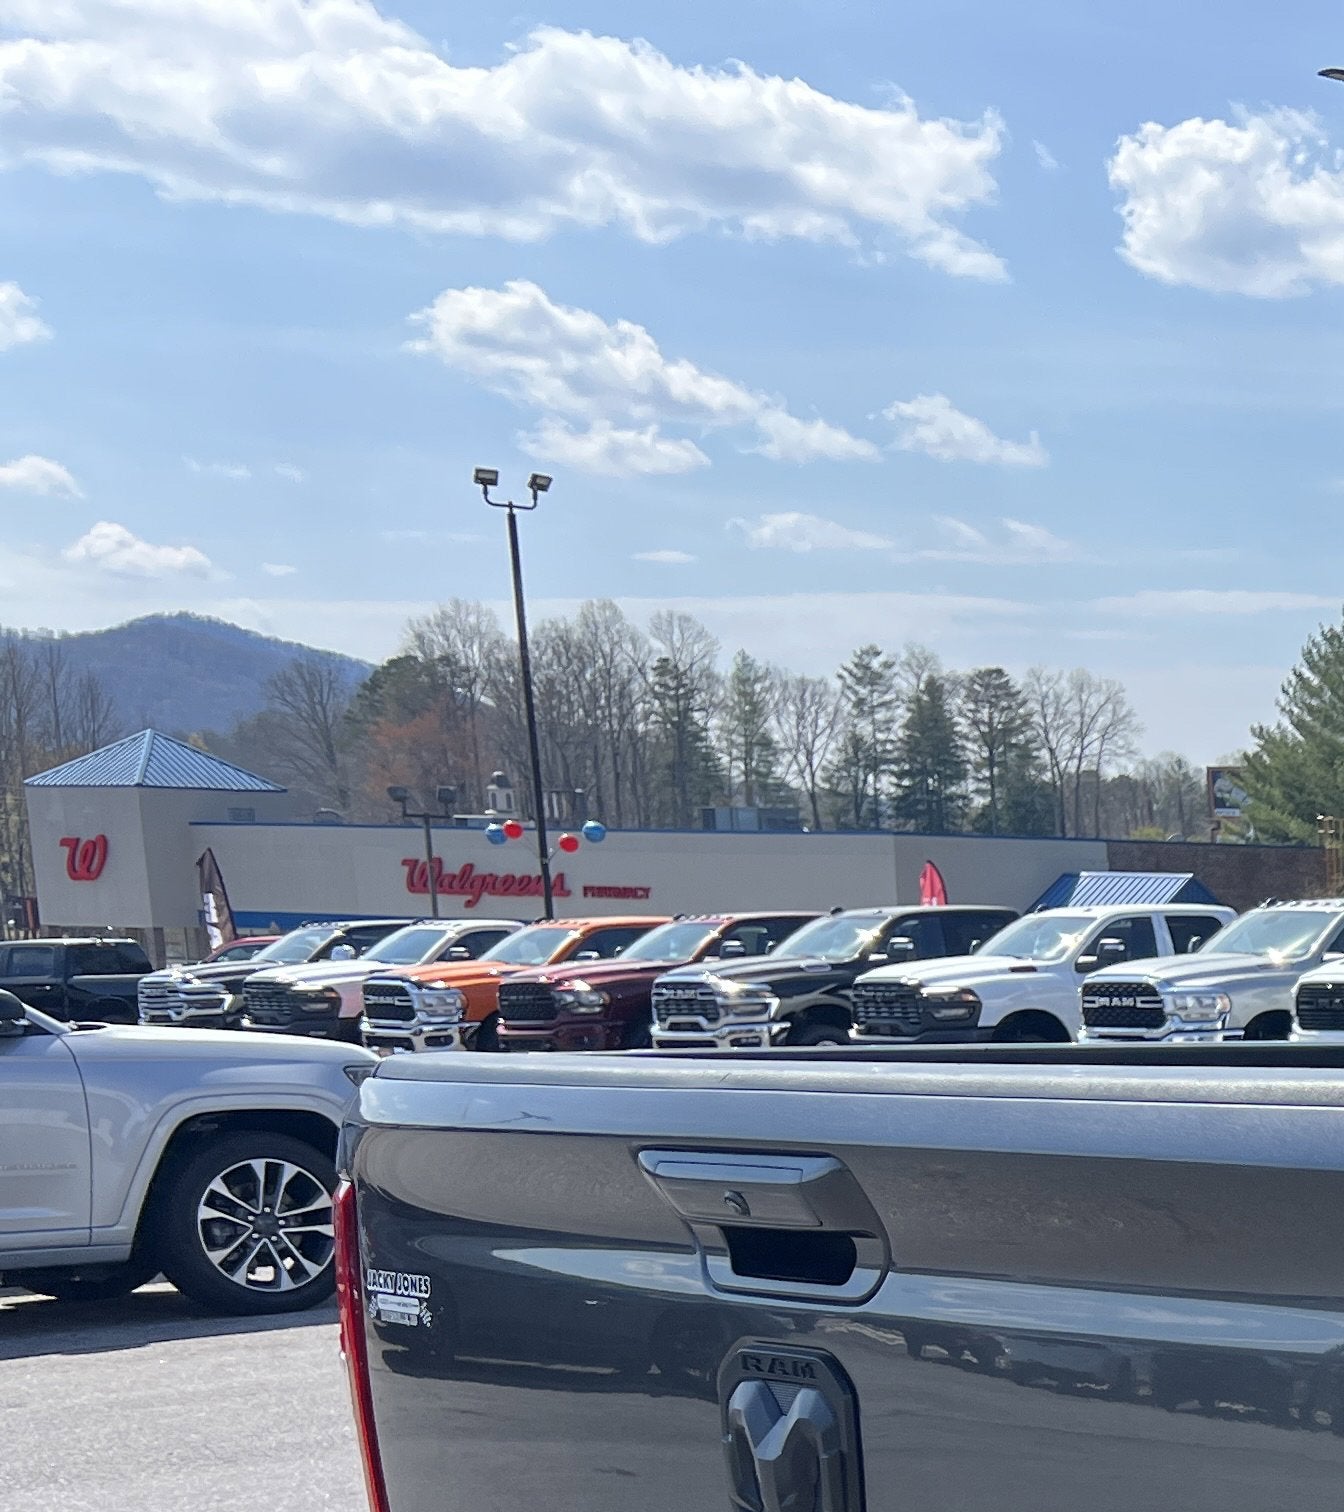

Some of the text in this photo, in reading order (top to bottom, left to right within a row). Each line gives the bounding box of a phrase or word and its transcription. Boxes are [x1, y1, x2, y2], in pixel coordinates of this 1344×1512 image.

[59, 834, 108, 881] W
[401, 857, 572, 908] Walgreens
[1099, 997, 1135, 1006] RAM
[367, 1269, 430, 1298] JACKY JONES
[741, 1354, 817, 1379] RAM
